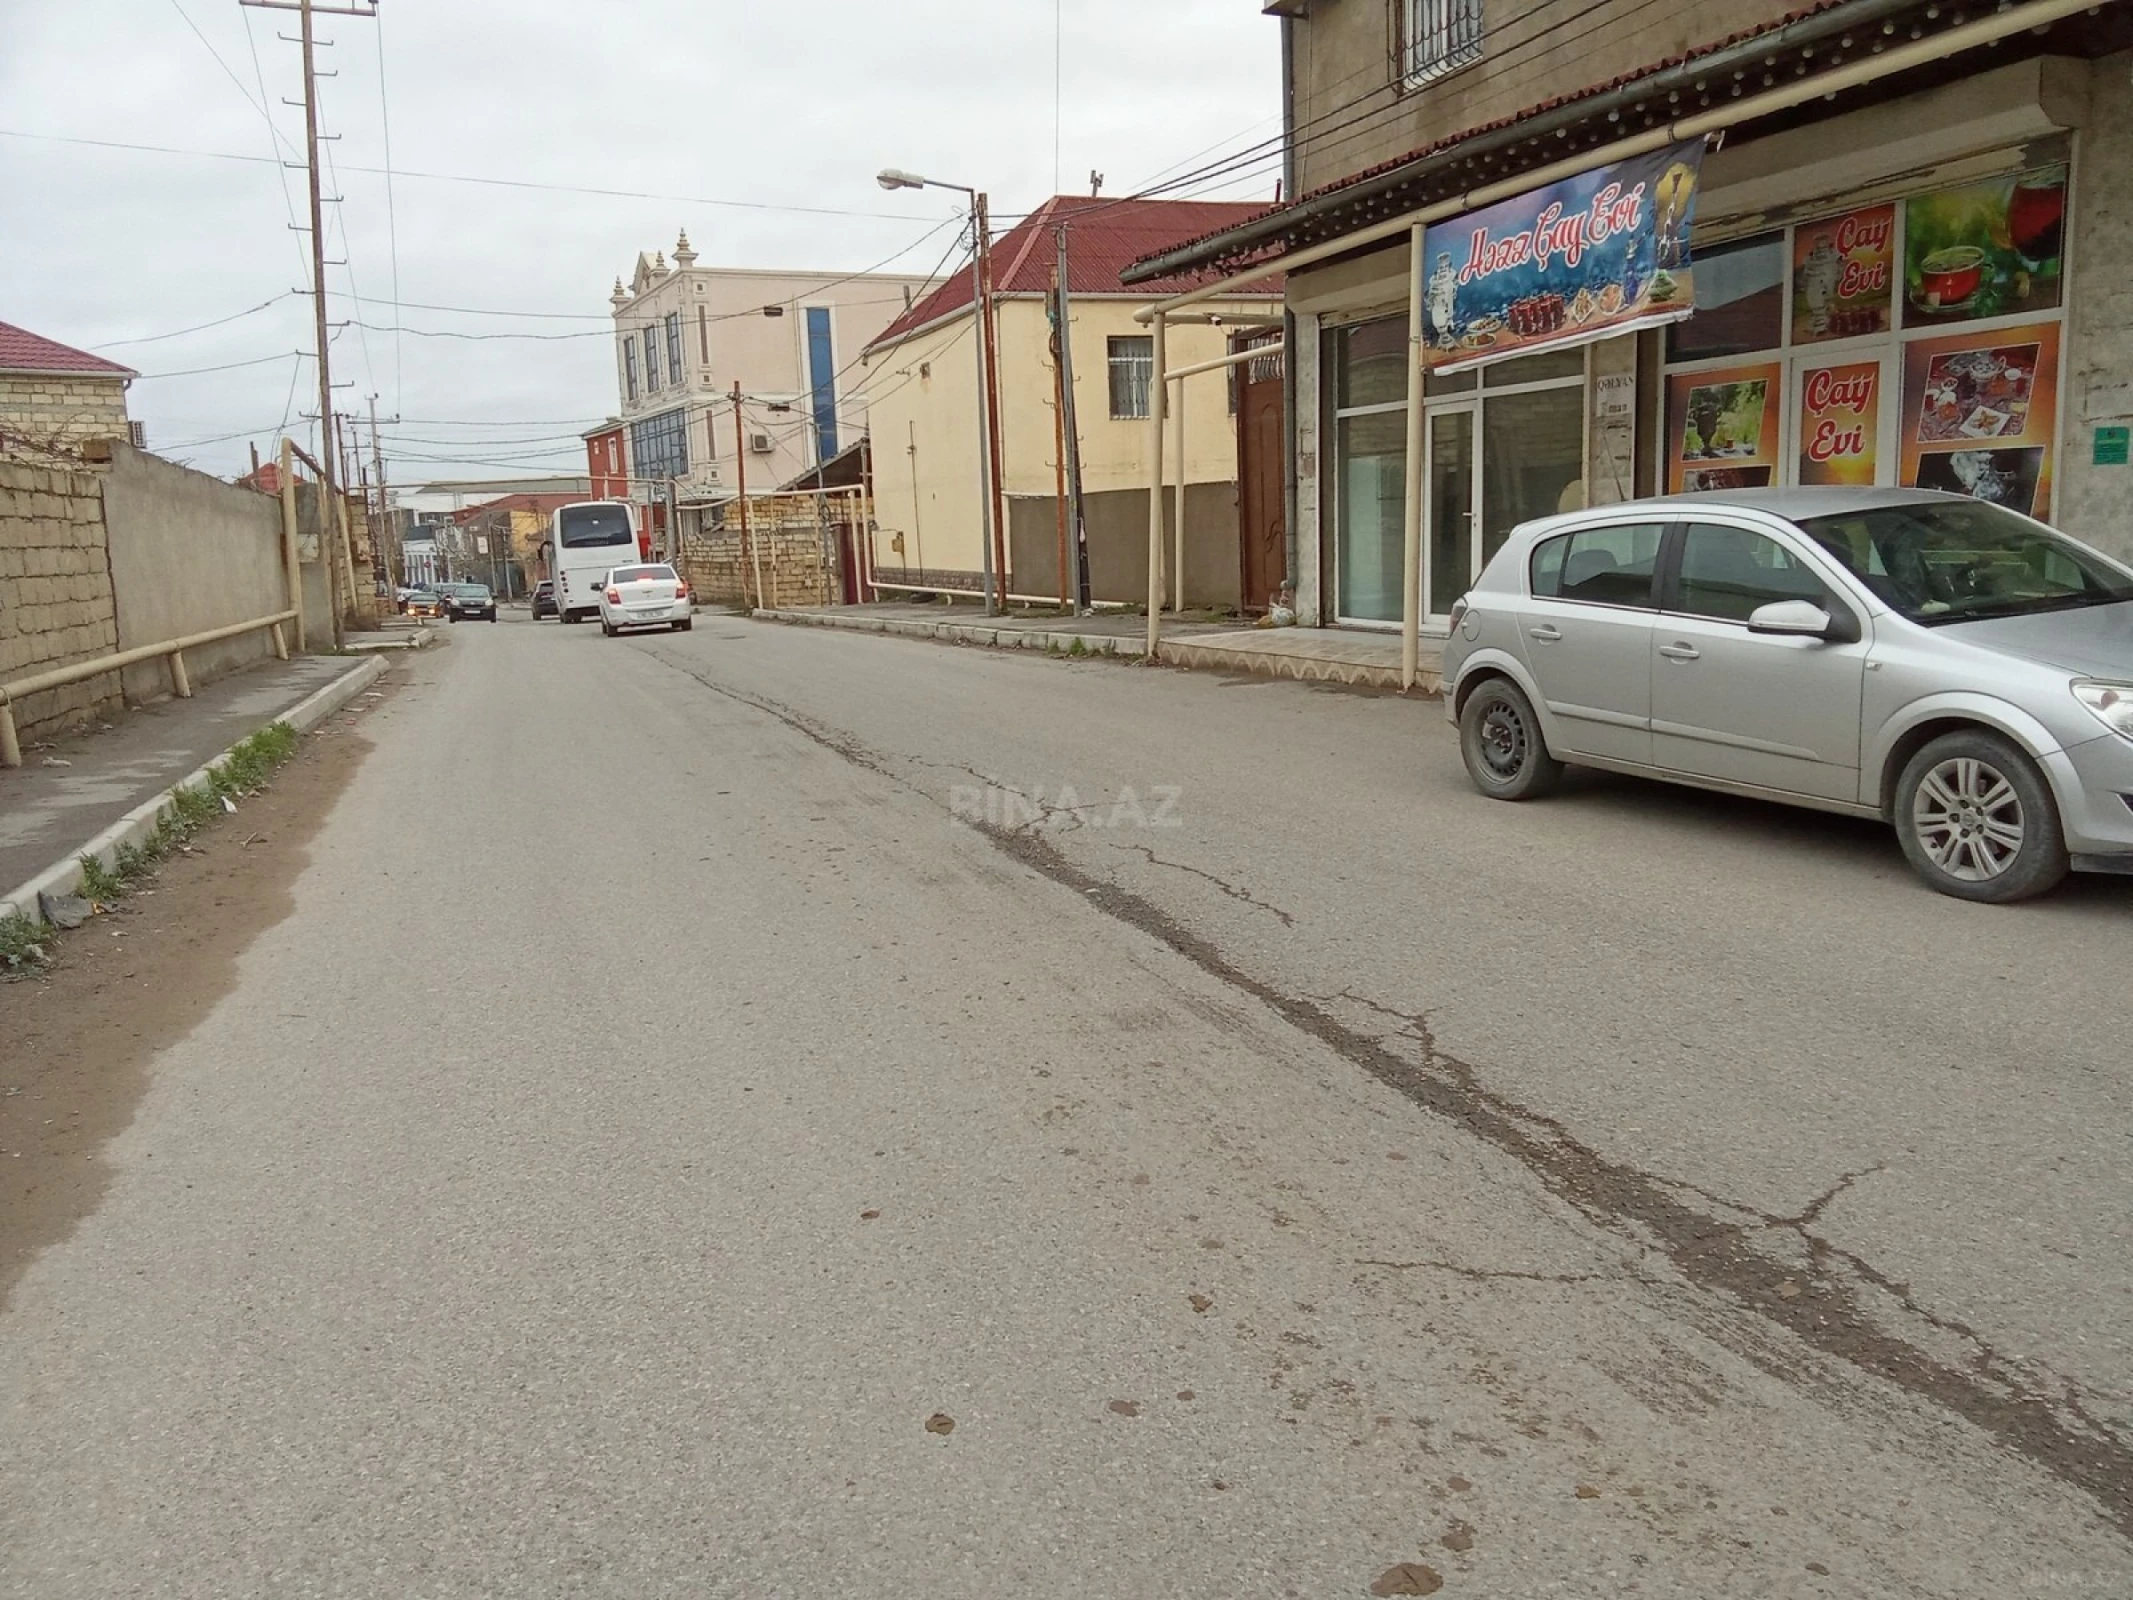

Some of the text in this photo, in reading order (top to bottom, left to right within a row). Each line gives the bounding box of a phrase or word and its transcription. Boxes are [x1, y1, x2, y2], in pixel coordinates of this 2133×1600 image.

[1460, 181, 1645, 285] Həzz Çay Evi
[1836, 216, 1893, 259] Çay
[1838, 260, 1885, 299] Evi
[1806, 370, 1875, 417] Çay
[1808, 419, 1866, 461] Evi
